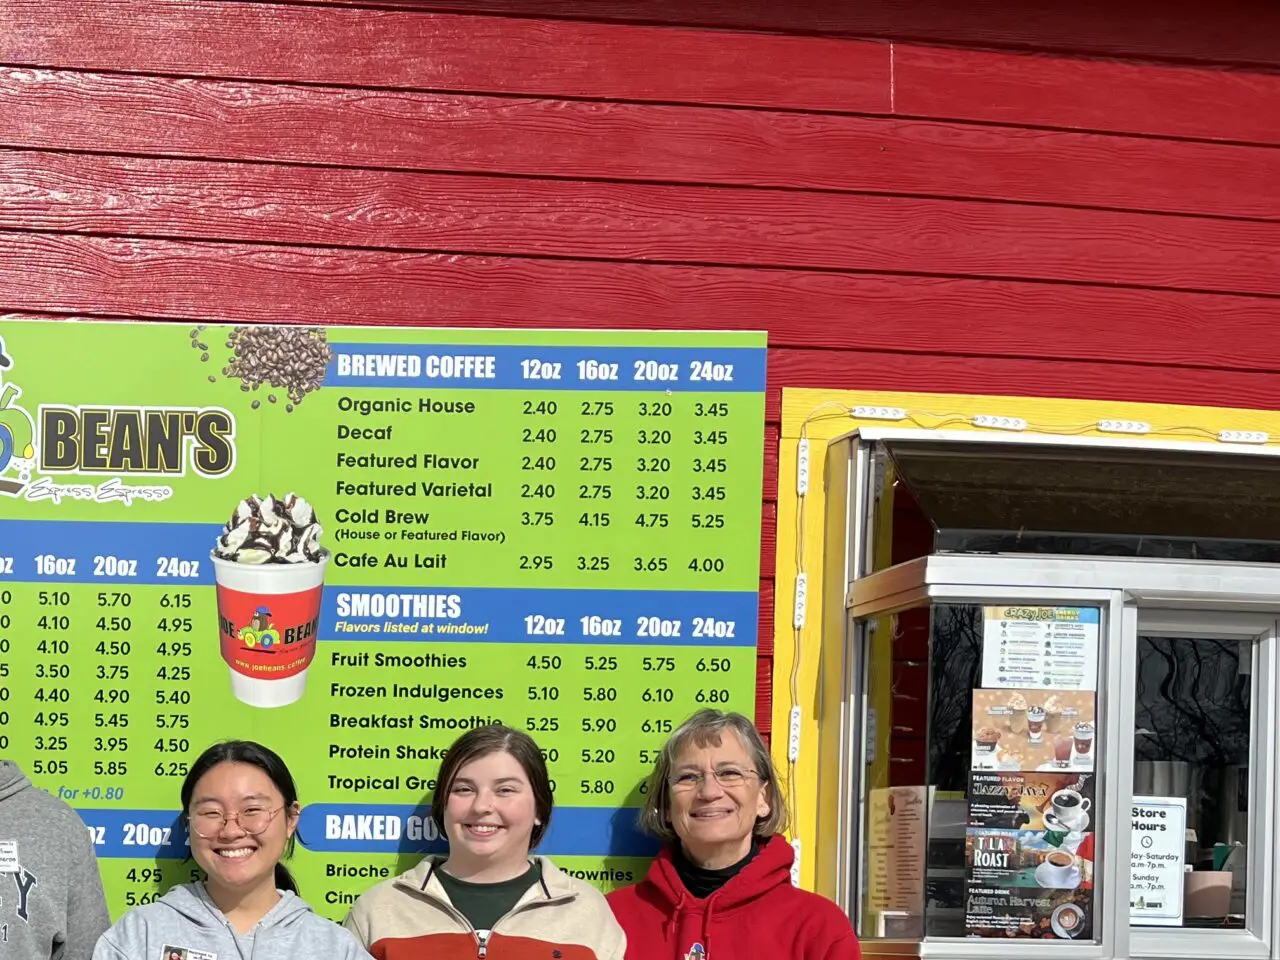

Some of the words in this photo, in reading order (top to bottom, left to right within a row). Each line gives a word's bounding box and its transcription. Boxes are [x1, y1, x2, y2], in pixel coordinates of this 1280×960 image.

[337, 354, 420, 377] BREWED
[426, 355, 496, 378] COFFEE
[521, 359, 561, 379] 12oz
[577, 360, 618, 381] 16oz
[634, 361, 678, 381] 20oz
[690, 361, 733, 383] 24oz
[338, 397, 412, 416] Organic
[419, 399, 475, 413] House
[523, 401, 557, 414] 2.40
[582, 402, 613, 415] 2.75
[639, 403, 672, 416] 3.20
[695, 403, 728, 416] 3.45
[40, 407, 233, 473] BEAN'S
[338, 425, 392, 440] Decaf
[337, 453, 417, 468] Featured
[424, 455, 479, 469] Flavor
[337, 481, 416, 496] Featured
[422, 483, 492, 497] Varietal
[336, 509, 378, 523] Cold
[386, 510, 429, 524] Brew
[522, 512, 553, 525] 3.75
[579, 513, 609, 526] 4.15
[635, 514, 668, 527] 4.75
[692, 515, 724, 528] 5.25
[335, 529, 380, 541] (House
[401, 530, 457, 540] Featured
[462, 531, 506, 544] Flavor)
[35, 555, 76, 576] 16oz
[94, 556, 137, 576] 20oz
[157, 557, 199, 577] 24oz
[335, 553, 378, 567] Cafe
[384, 554, 407, 567] Au
[415, 554, 446, 568] Lait
[520, 556, 553, 569] 2.95
[578, 557, 609, 570] 3.25
[634, 558, 667, 571] 3.65
[688, 559, 724, 572] 4.00
[39, 592, 70, 605] 5.10
[98, 593, 131, 606] 5.70
[160, 594, 191, 608] 6.15
[337, 593, 461, 618] SMOOTHIES
[335, 621, 380, 632] Flavors
[384, 622, 419, 633] listed
[421, 624, 434, 634] at
[437, 623, 489, 634] window!
[524, 615, 565, 635] 12oz
[580, 616, 622, 636] 16oz
[637, 617, 681, 637] 20oz
[692, 618, 735, 638] 24oz
[332, 653, 369, 666] Fruit
[375, 653, 466, 667] Smoothies
[527, 656, 561, 669] 4.50
[585, 657, 617, 670] 5.25
[643, 658, 675, 671] 5.75
[696, 658, 730, 672] 6.50
[36, 664, 69, 678] 3.50
[97, 665, 128, 679] 3.75
[157, 667, 190, 680] 4.25
[35, 688, 69, 702] 4.40
[94, 690, 129, 703] 4.90
[156, 691, 190, 704] 5.40
[331, 683, 386, 697] Frozen
[394, 684, 503, 702] Indulgences
[528, 687, 558, 700] 5.10
[584, 688, 616, 701] 5.80
[642, 689, 673, 702] 6.10
[696, 690, 729, 703] 6.80
[34, 713, 68, 726] 4.95
[95, 714, 128, 727] 5.45
[157, 715, 189, 728] 5.75
[330, 714, 414, 728] Breakfast
[527, 718, 558, 731] 5.25
[583, 719, 616, 732] 5.90
[641, 719, 672, 734] 6.15
[35, 736, 67, 750] 3.25
[95, 738, 128, 751] 3.95
[154, 739, 189, 752] 4.50
[330, 745, 390, 758] Protein
[34, 760, 67, 774] 5.05
[95, 761, 127, 775] 5.85
[154, 762, 188, 778] 6.25
[328, 775, 399, 792] Tropical
[58, 784, 80, 800] for
[83, 787, 125, 800] +0.80
[1131, 807, 1167, 818] Store
[325, 815, 401, 841] BAKED
[1131, 820, 1167, 831] Hours
[122, 823, 171, 846] 20oz
[974, 849, 1010, 867] ROAST
[126, 868, 163, 883] 4.95
[327, 864, 389, 877] Brioche
[1132, 873, 1159, 881] Sunday
